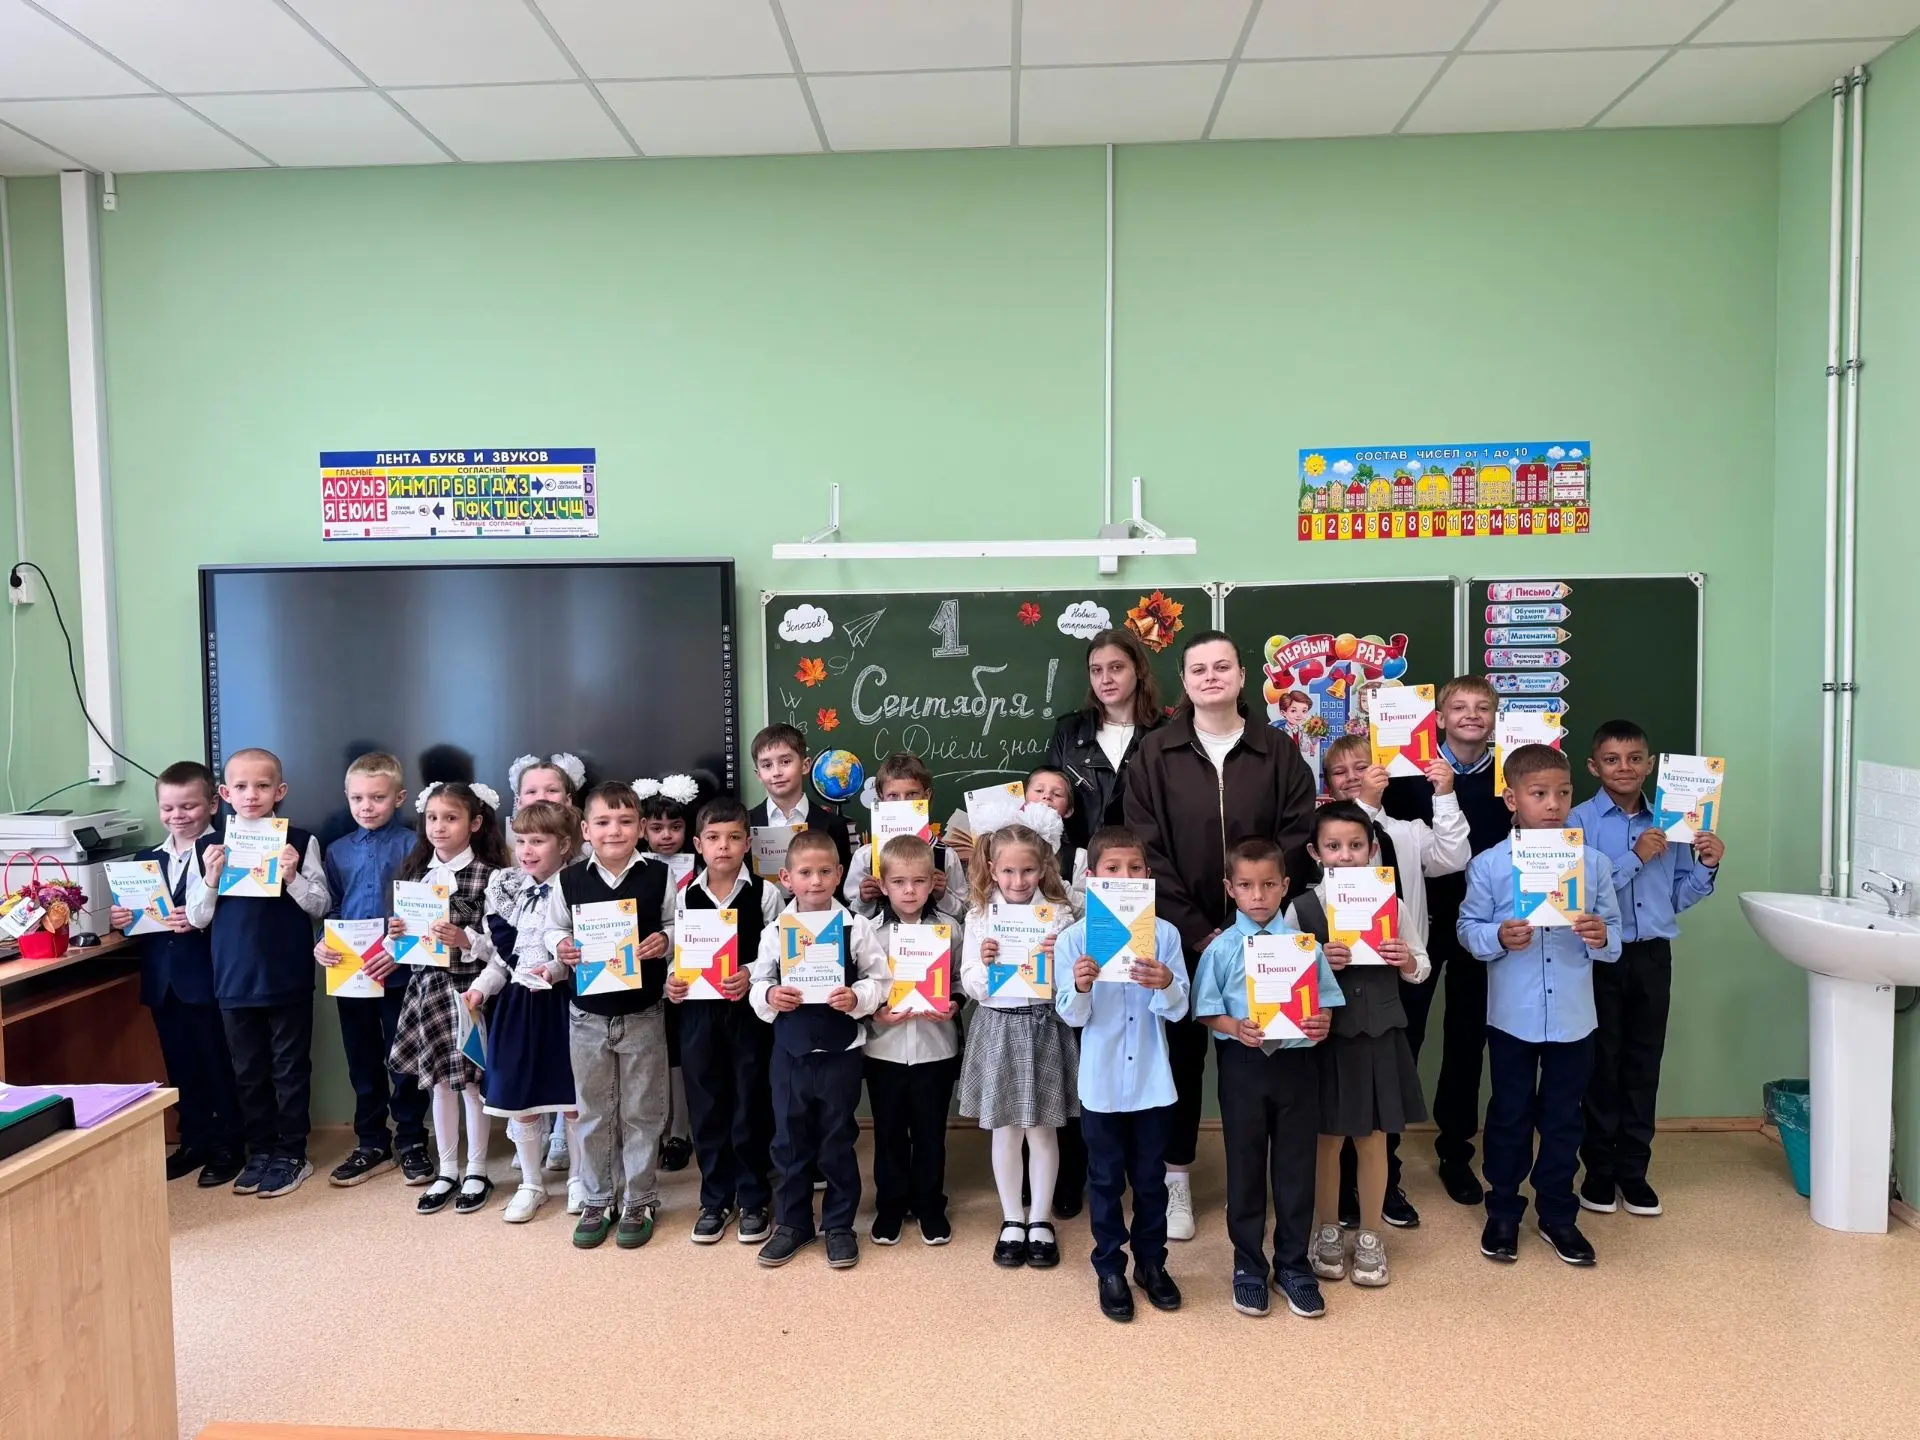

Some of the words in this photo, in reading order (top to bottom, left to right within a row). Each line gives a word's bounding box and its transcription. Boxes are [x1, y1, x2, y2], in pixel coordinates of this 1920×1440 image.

[376, 453, 421, 464] ЛЕНТА
[430, 452, 465, 463] БУКВ
[474, 452, 483, 462] И
[493, 451, 548, 462] ЗВУКОВ
[1355, 451, 1408, 461] СОСТАВ
[1416, 449, 1460, 459] ЧИСЕЛ
[1465, 450, 1479, 458] от
[1483, 448, 1489, 457] 1
[1493, 449, 1509, 458] до
[1514, 447, 1528, 456] 10
[336, 468, 372, 476] ГЛАСНЫЕ
[1301, 519, 1309, 534] 0
[1315, 518, 1322, 534] 1
[1327, 518, 1336, 534] 2
[1341, 518, 1349, 533] 3
[1354, 517, 1363, 533] 4
[1368, 517, 1376, 532] 5
[1381, 516, 1390, 532] 6
[1395, 516, 1403, 532] 7
[1408, 515, 1417, 531] 8
[1422, 515, 1430, 531] 9
[1433, 515, 1446, 530] 10
[1449, 514, 1459, 530] 11
[1462, 514, 1474, 529] 12
[1477, 514, 1489, 529] 13
[1491, 514, 1502, 529] 14
[1505, 513, 1517, 529] 15
[1519, 513, 1531, 528] 16
[1533, 513, 1545, 528] 17
[1548, 512, 1560, 527] 18
[1562, 512, 1574, 527] 19
[1576, 511, 1588, 527] 20
[1515, 587, 1551, 597] Письмо
[1070, 608, 1097, 619] Новых
[785, 615, 826, 633] Успехов!
[929, 599, 969, 657] 1
[1510, 632, 1556, 640] Математика
[1277, 636, 1330, 666] ПЕРВЫЙ
[1356, 643, 1386, 664] РАЗ
[1380, 712, 1417, 722] Прописи
[902, 724, 988, 760] Днём
[1414, 729, 1432, 761] 1
[1662, 773, 1716, 784] Математика
[1697, 800, 1714, 832] 1
[881, 824, 913, 834] Прописи
[229, 832, 280, 841] Математика
[1516, 850, 1576, 859] Математика
[263, 856, 279, 885] 1
[1338, 893, 1377, 904] Прописи
[1562, 876, 1582, 911] 1
[396, 899, 443, 909] Математика
[577, 920, 631, 932] Математика
[993, 924, 1046, 933] Математика
[684, 933, 719, 944] Прописи
[899, 946, 933, 957] Прописи
[620, 943, 638, 976] 1
[1032, 951, 1049, 984] 1
[1257, 963, 1297, 975] Прописи
[789, 974, 841, 983] Математика
[930, 966, 947, 998] 1
